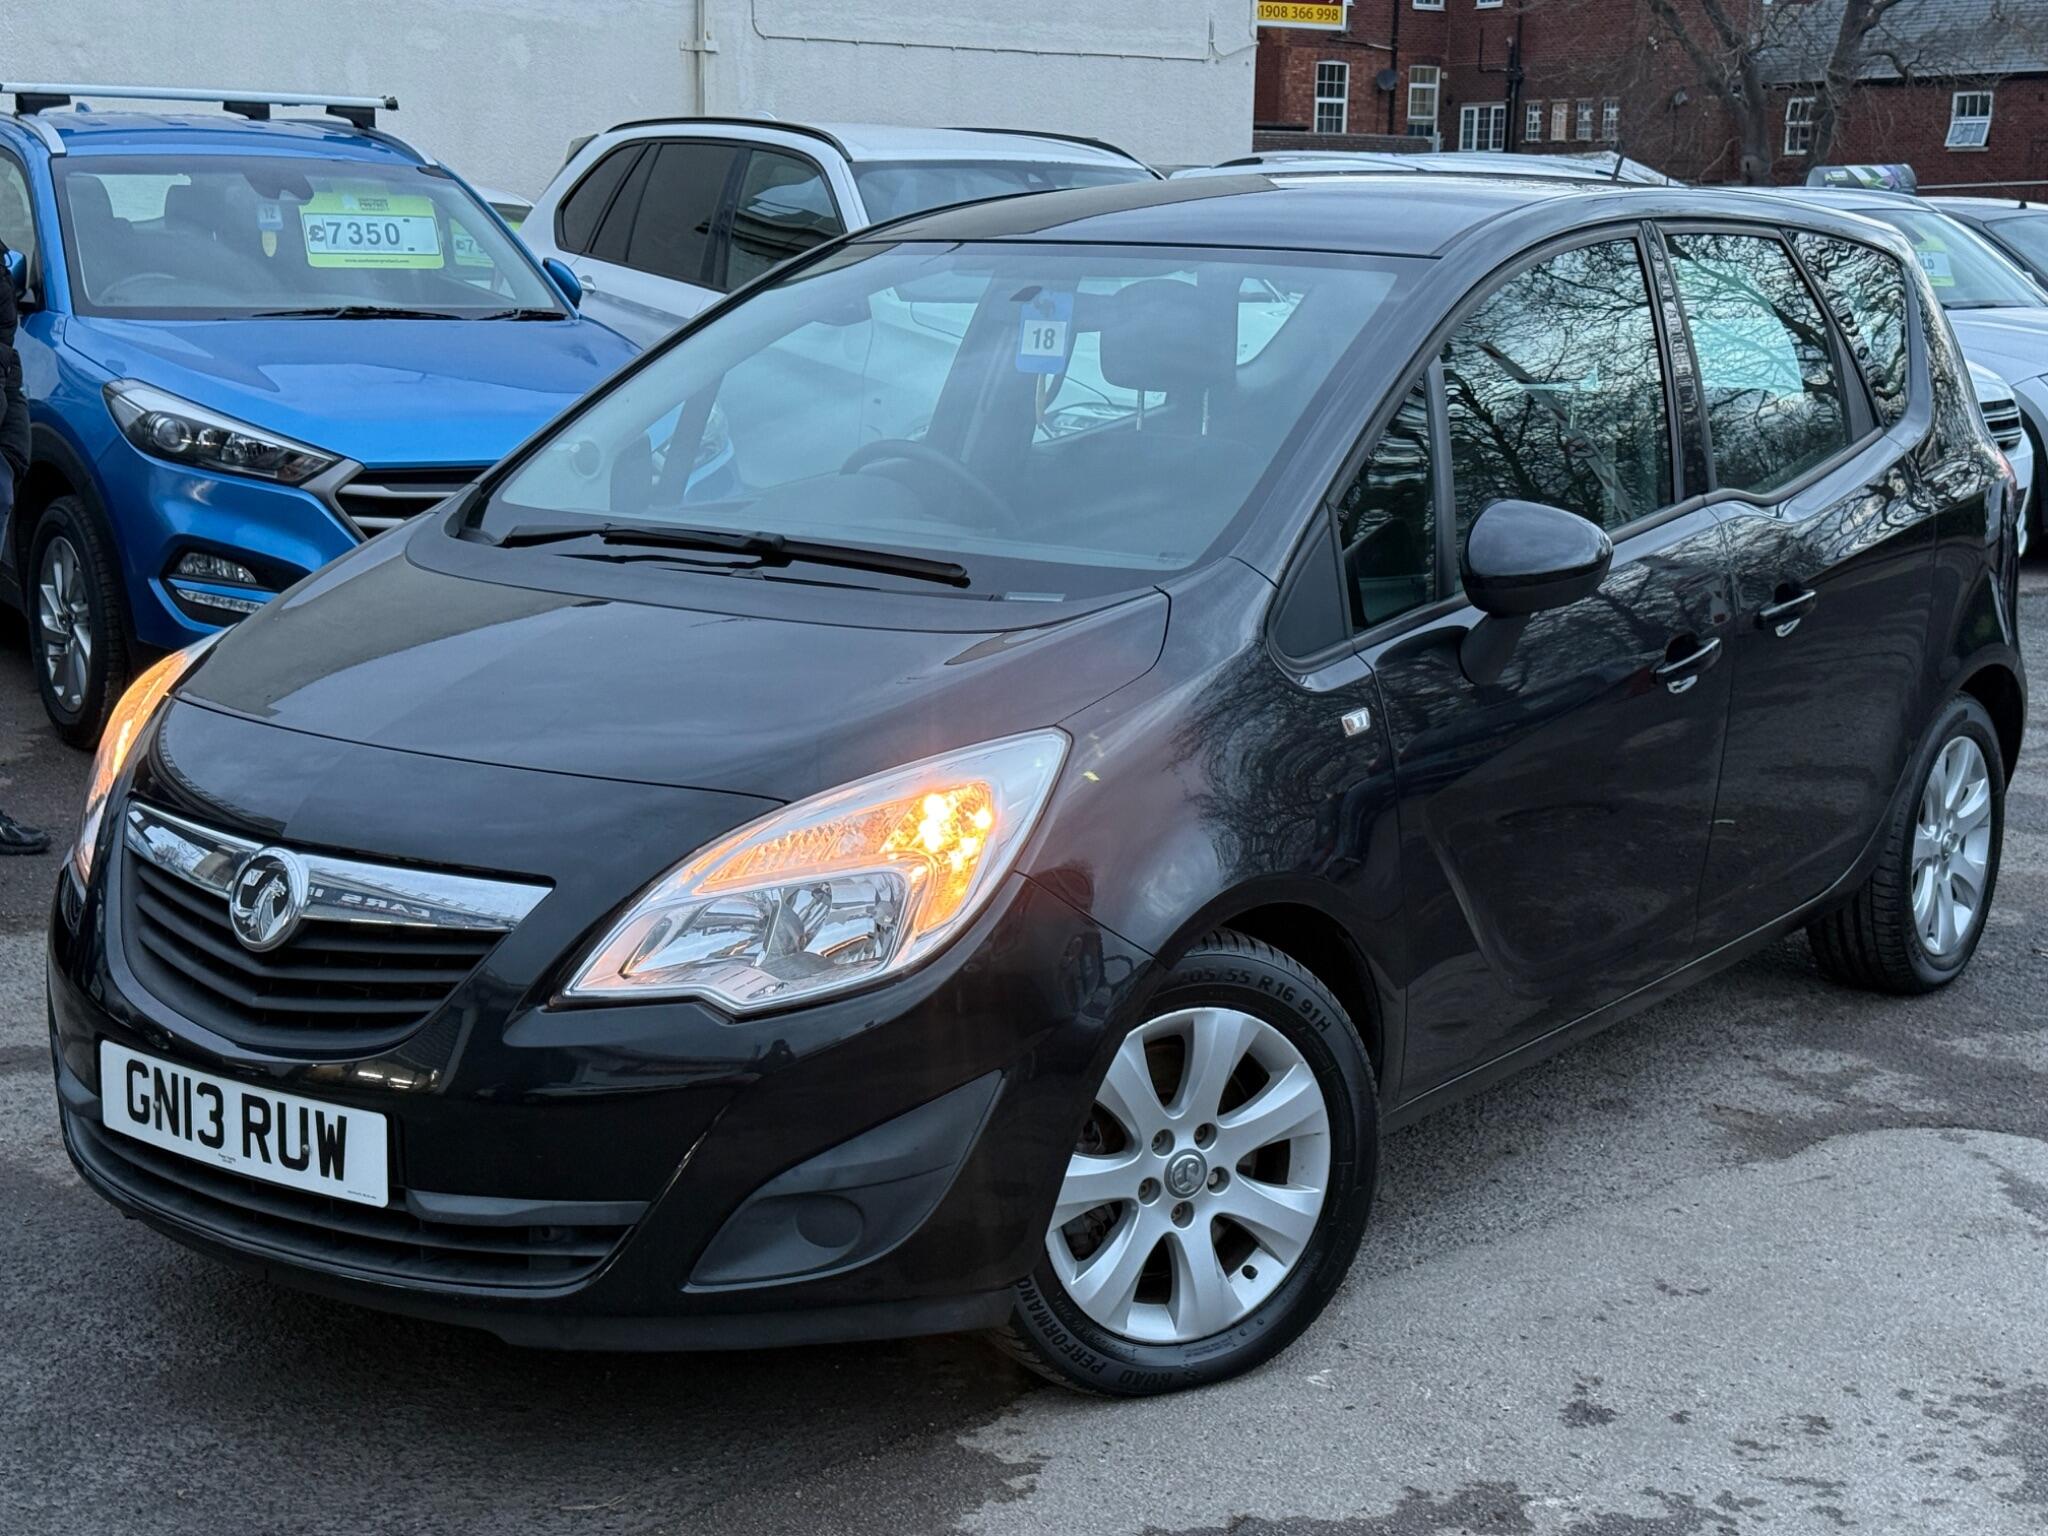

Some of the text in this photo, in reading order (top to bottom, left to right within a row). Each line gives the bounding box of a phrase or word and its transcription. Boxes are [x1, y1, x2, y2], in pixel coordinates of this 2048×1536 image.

[1257, 5, 1339, 21] 1908 366 998
[309, 222, 401, 246] £7350
[1032, 327, 1056, 350] 18
[126, 1058, 348, 1182] GN13 RUW
[1118, 1370, 1174, 1386] ROAD
